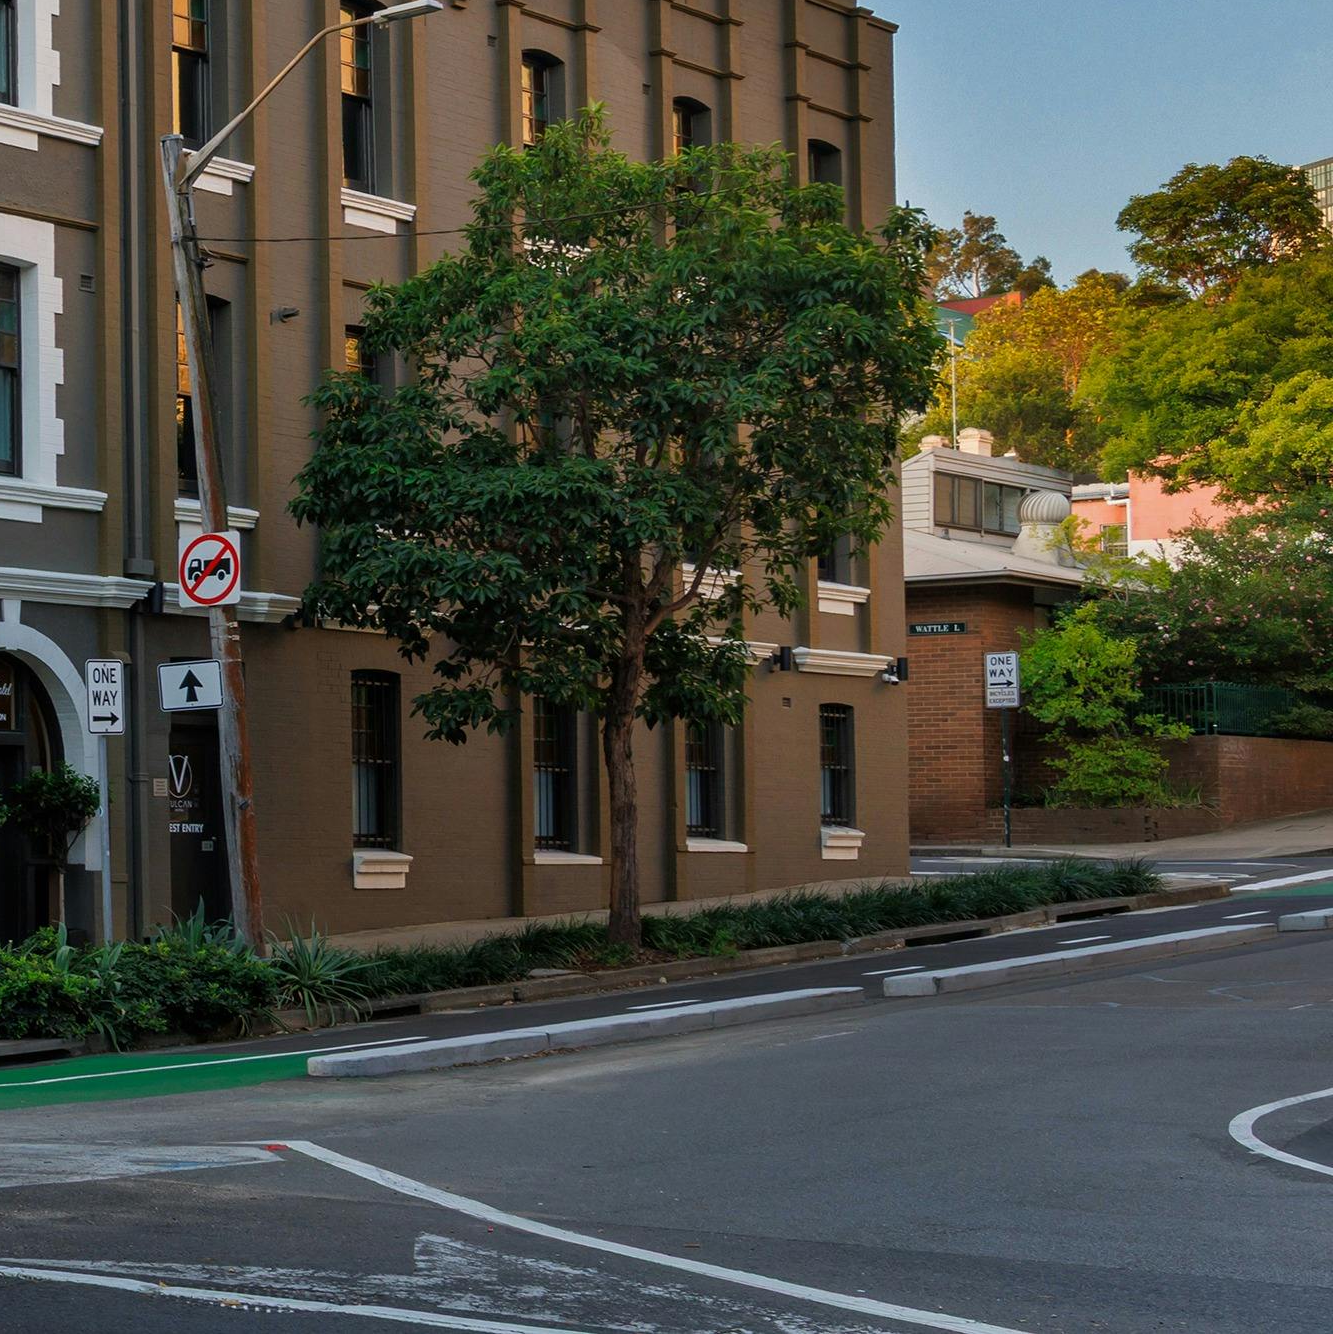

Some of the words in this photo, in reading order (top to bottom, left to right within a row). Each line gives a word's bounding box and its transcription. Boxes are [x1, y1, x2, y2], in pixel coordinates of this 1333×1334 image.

[915, 624, 949, 633] WATTLE
[990, 656, 1012, 666] ONE
[93, 668, 117, 684] ONE
[989, 668, 1014, 678] WAY
[92, 690, 118, 706] WAY
[170, 800, 192, 808] ULCAN
[169, 823, 180, 833] EST
[182, 823, 204, 833] ENTRY
